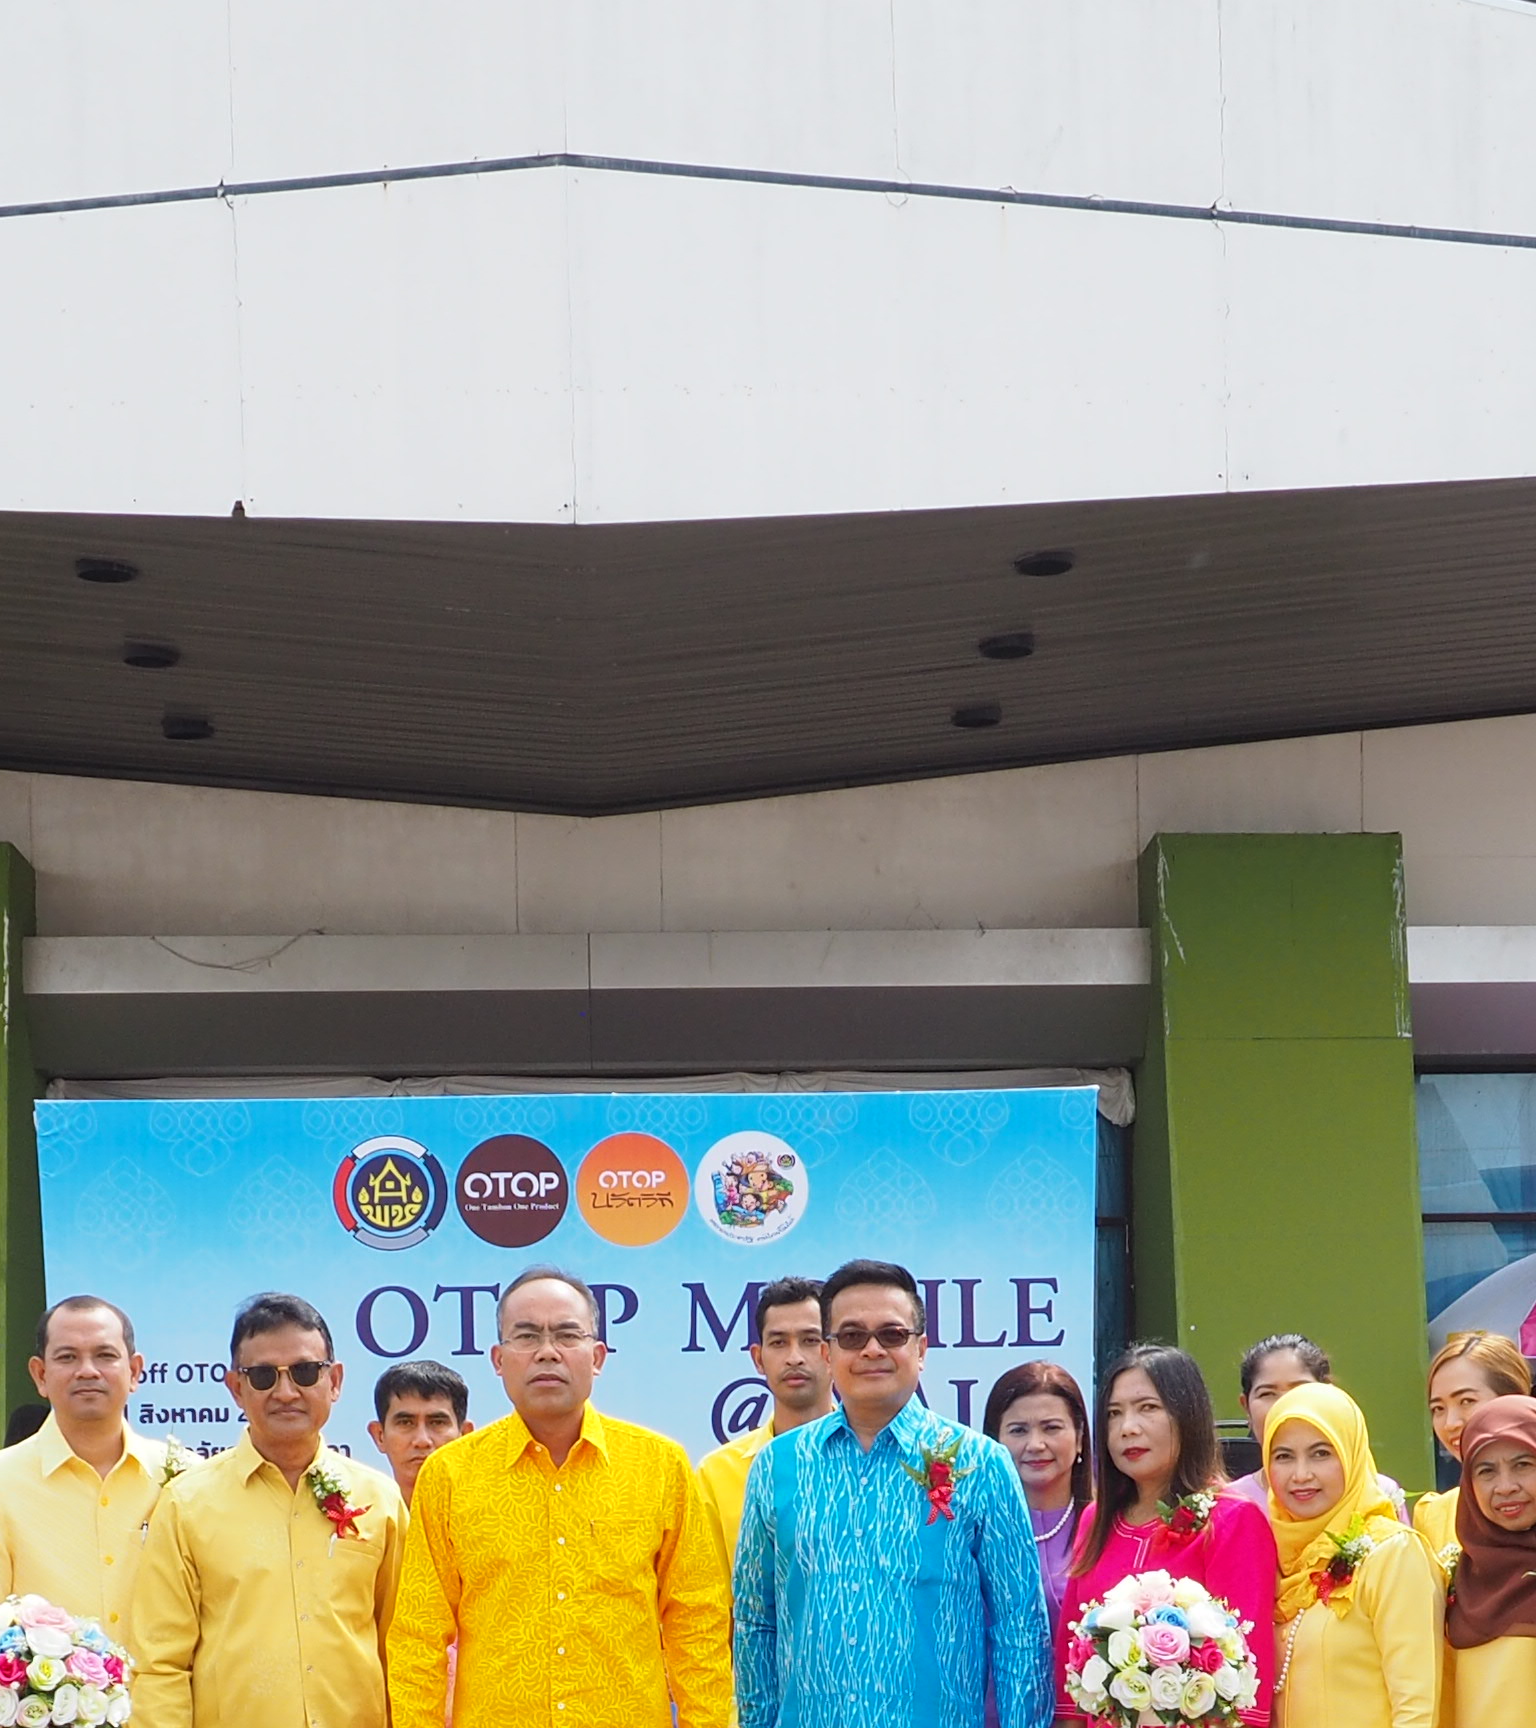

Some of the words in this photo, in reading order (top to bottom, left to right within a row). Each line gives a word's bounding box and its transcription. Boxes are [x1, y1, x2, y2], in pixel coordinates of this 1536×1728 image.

[464, 1171, 560, 1199] OTOP
[598, 1170, 666, 1189] OTOP
[355, 1282, 640, 1359] OTP
[681, 1277, 1066, 1353] MILE
[175, 1363, 228, 1384] OTO
[139, 1404, 230, 1424] สิงหาคม
